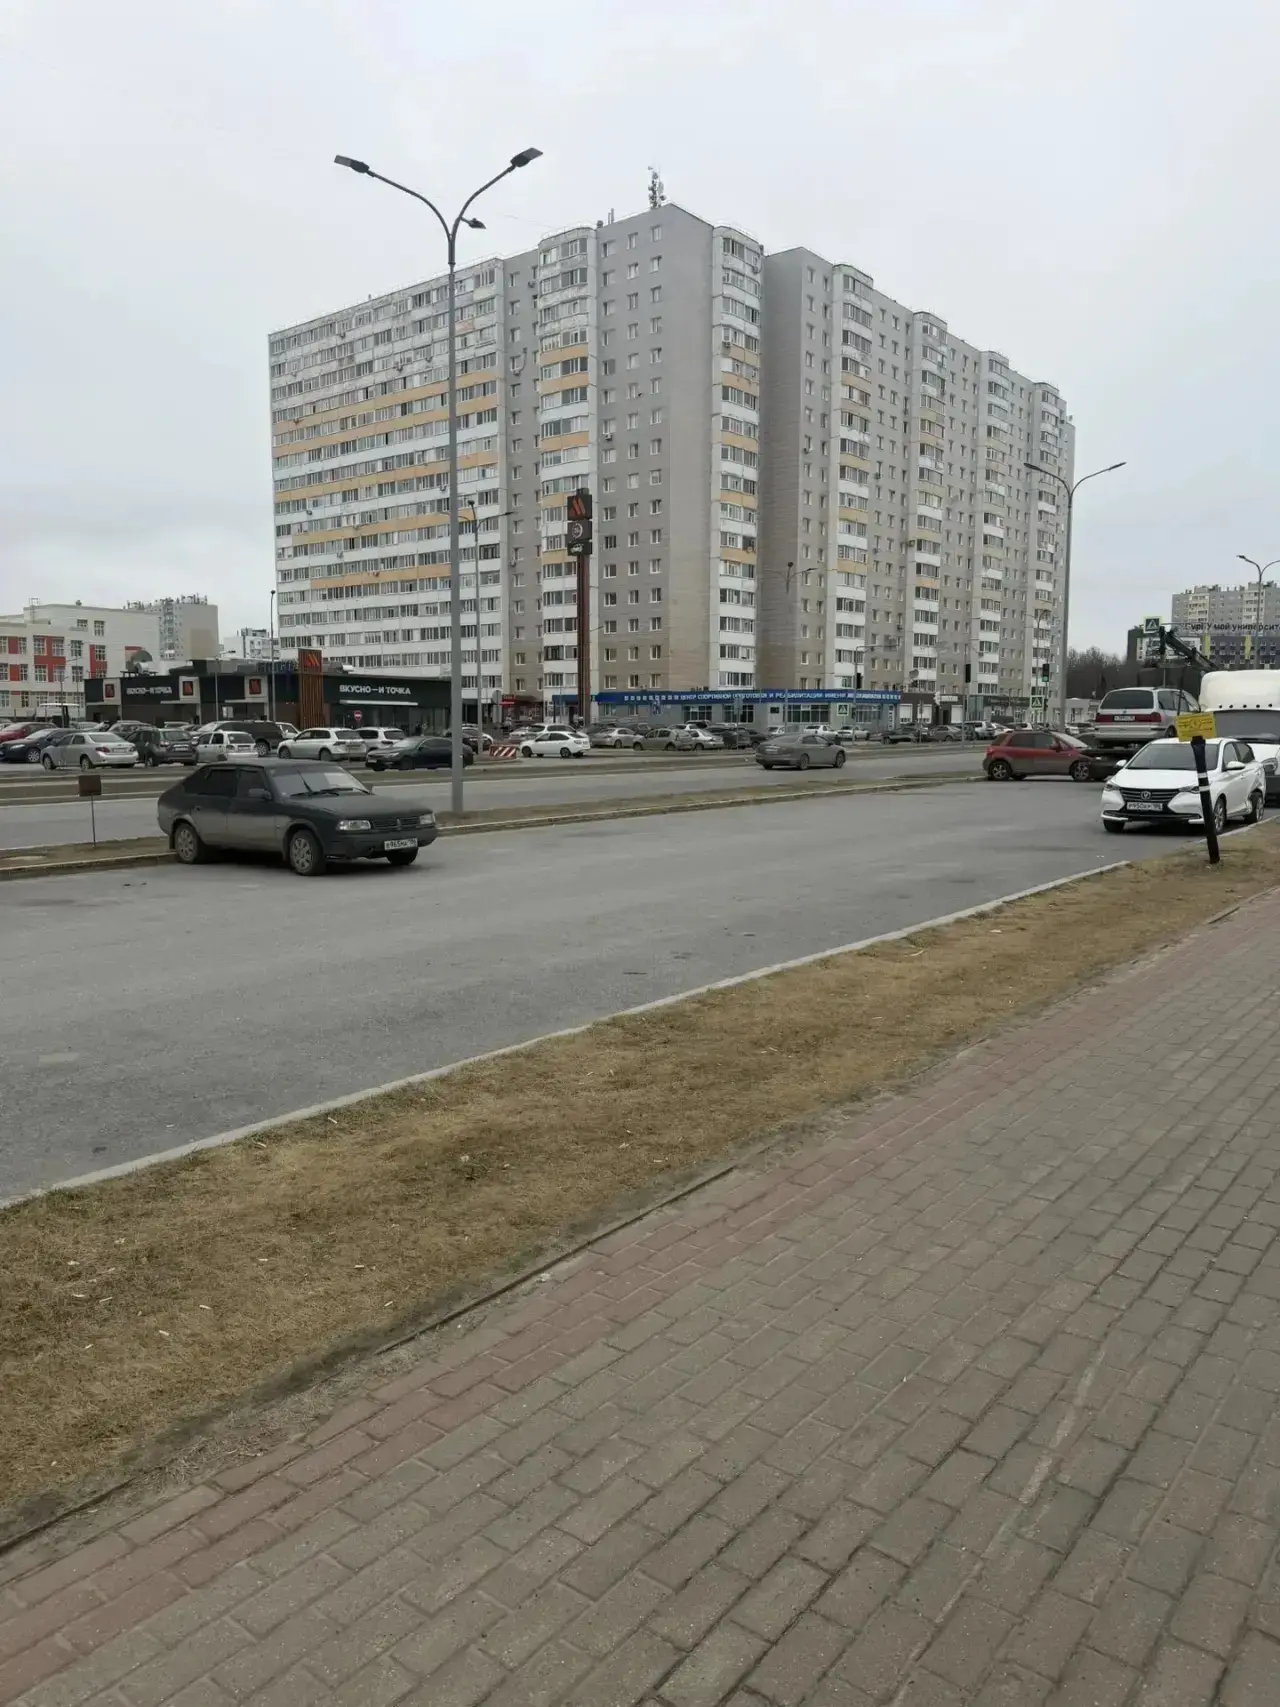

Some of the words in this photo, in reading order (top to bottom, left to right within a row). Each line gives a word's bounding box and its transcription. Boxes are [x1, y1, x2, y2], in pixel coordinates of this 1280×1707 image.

[1214, 622, 1230, 631] мой
[1232, 623, 1280, 632] униврсит
[386, 687, 411, 695] ТОЧКА
